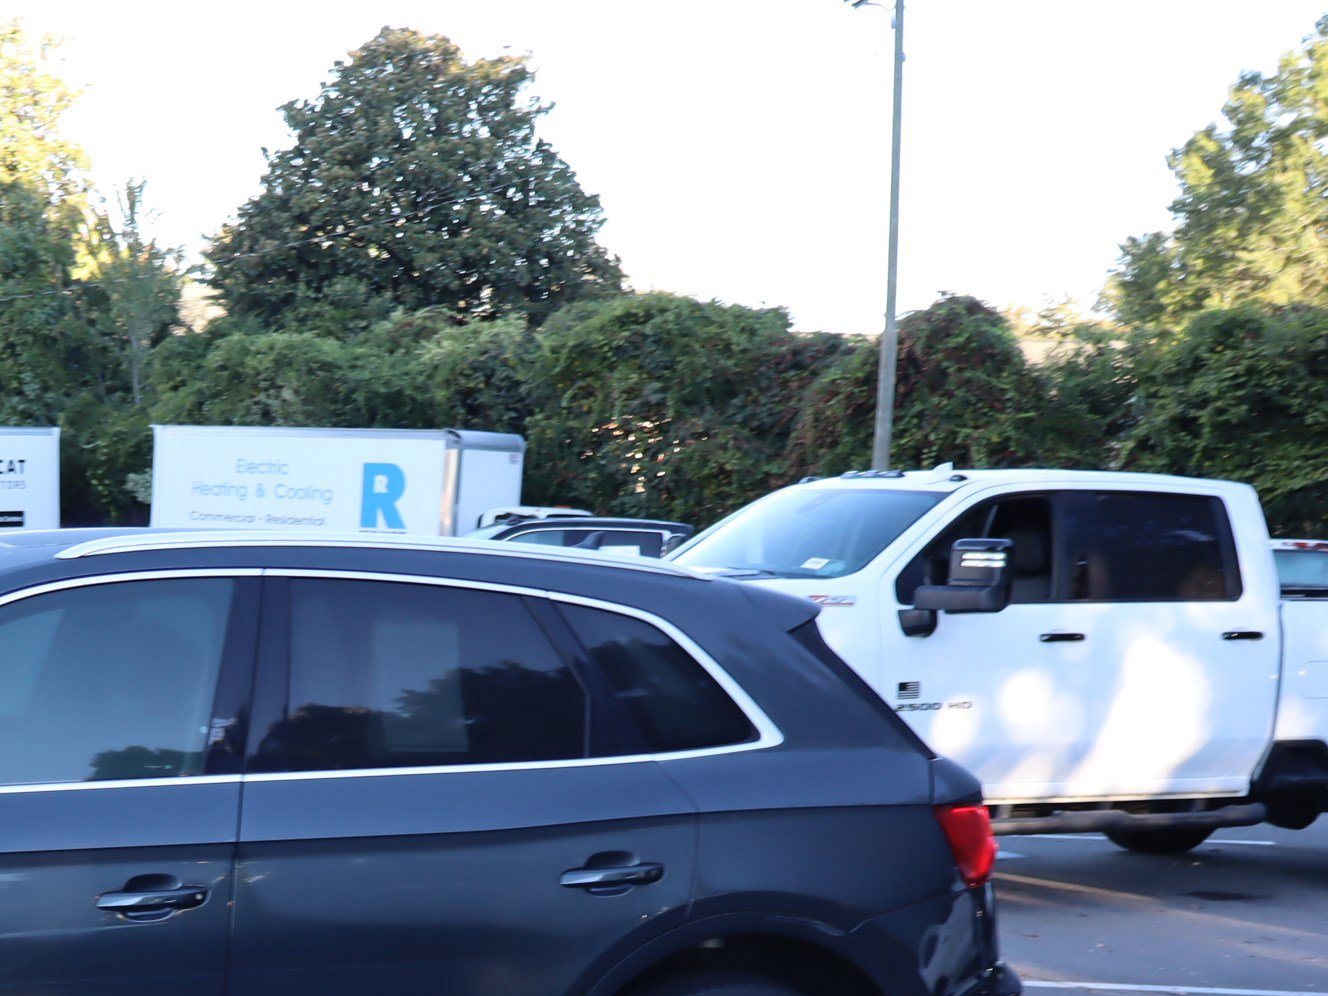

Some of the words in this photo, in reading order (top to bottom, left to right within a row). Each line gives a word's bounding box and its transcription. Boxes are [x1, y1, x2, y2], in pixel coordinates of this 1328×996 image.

[235, 458, 289, 475] Electric
[191, 481, 248, 501] Heating
[256, 482, 265, 497] &
[274, 483, 333, 505] Cooling
[360, 462, 407, 529] R
[189, 511, 256, 524] Commercial
[266, 513, 325, 526] Residential
[893, 702, 942, 712] 2500
[948, 701, 973, 710] HD
